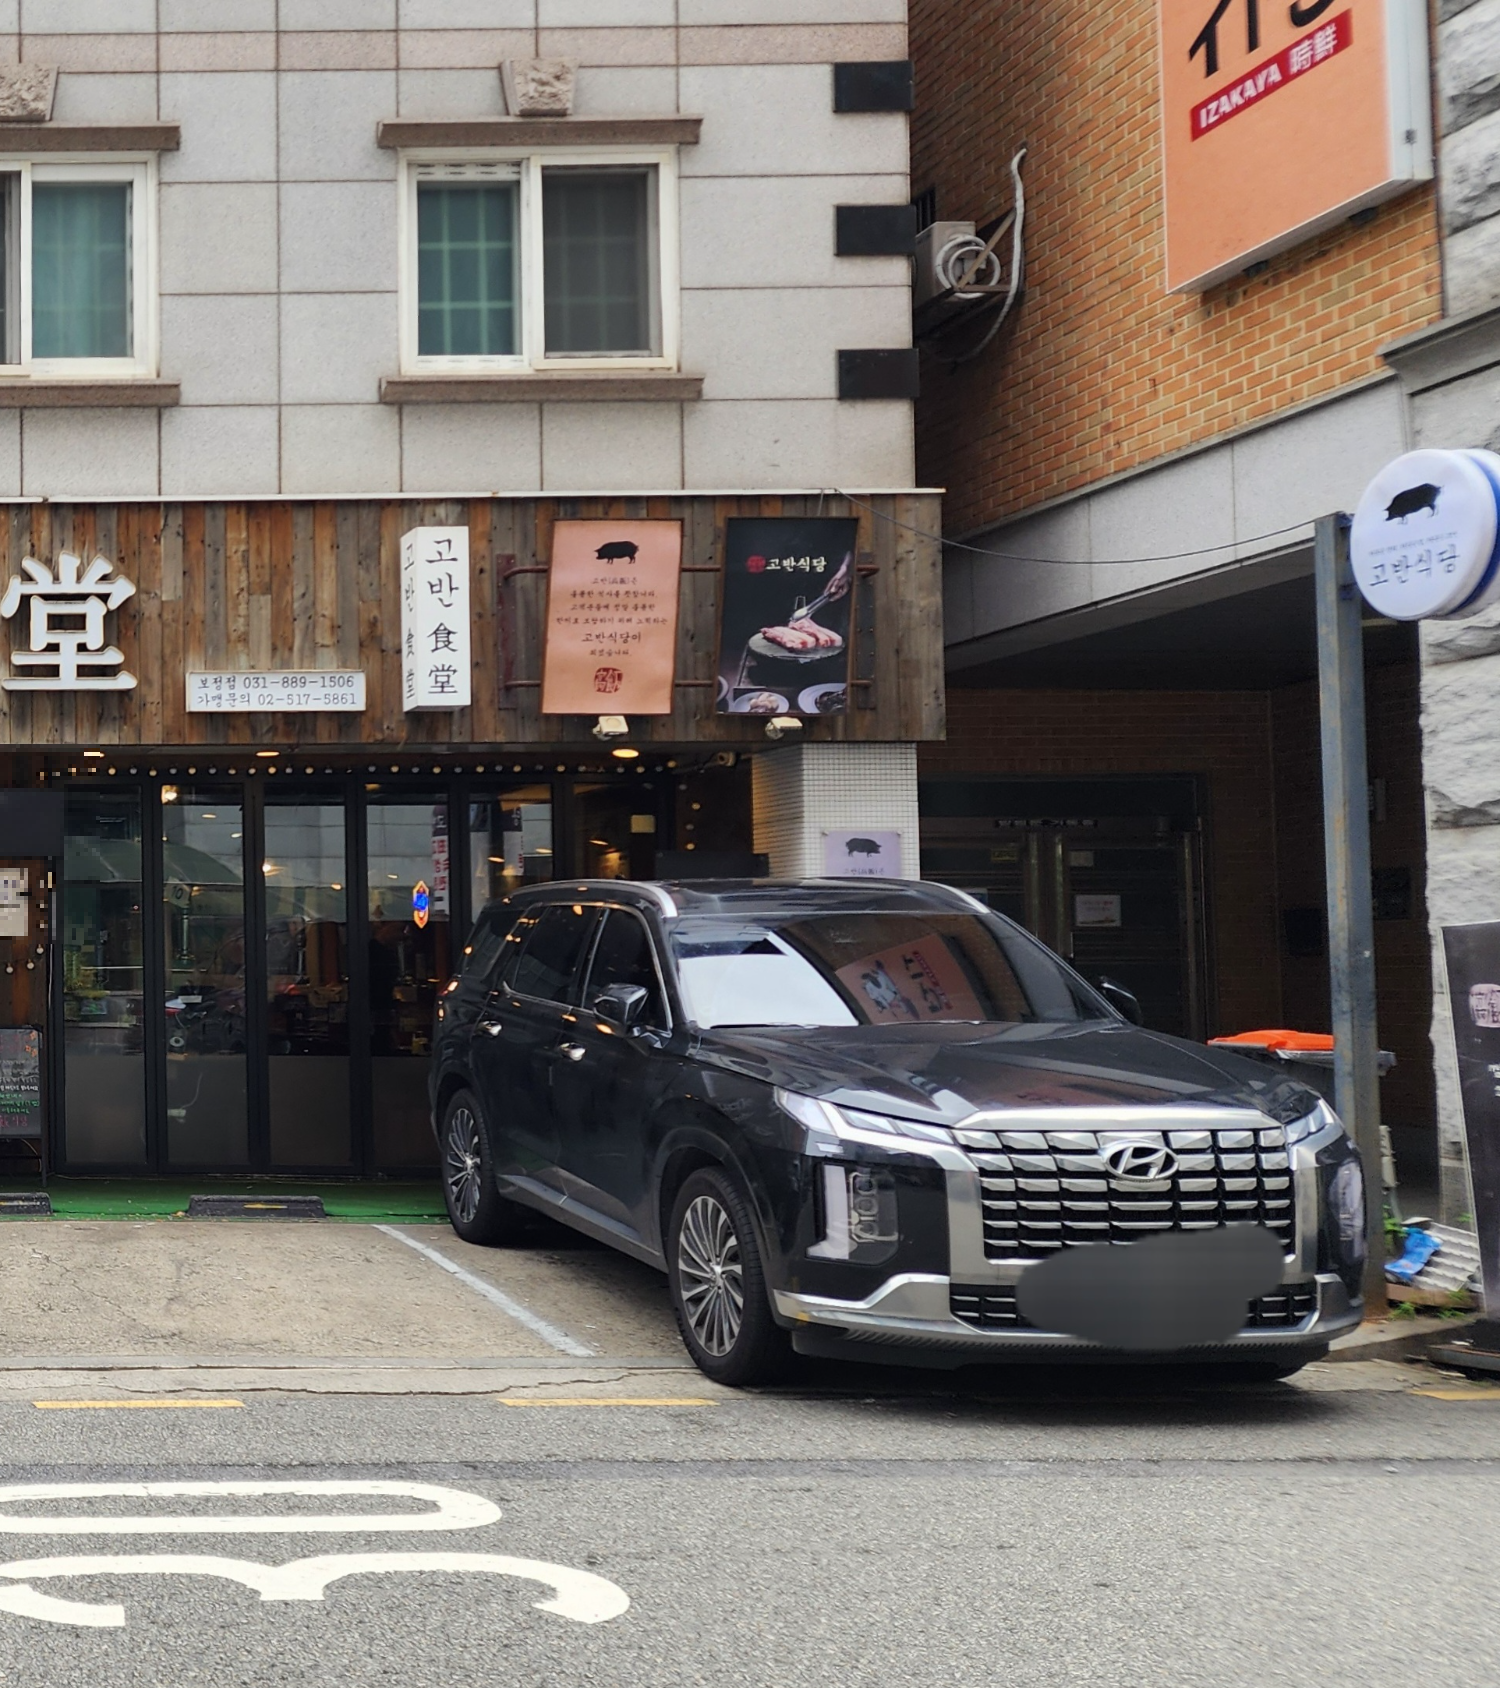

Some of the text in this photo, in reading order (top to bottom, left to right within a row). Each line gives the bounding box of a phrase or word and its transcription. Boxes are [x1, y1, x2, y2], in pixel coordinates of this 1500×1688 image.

[1199, 62, 1282, 129] IZAKAYA
[765, 556, 828, 573] 고반식당
[1368, 543, 1461, 587] 고반식당
[425, 538, 460, 694] 고반食堂
[581, 631, 641, 644] 고반식당이
[198, 675, 355, 690] 보정점 031-889-1506
[198, 692, 357, 708] 가맹문의 02-517-5861
